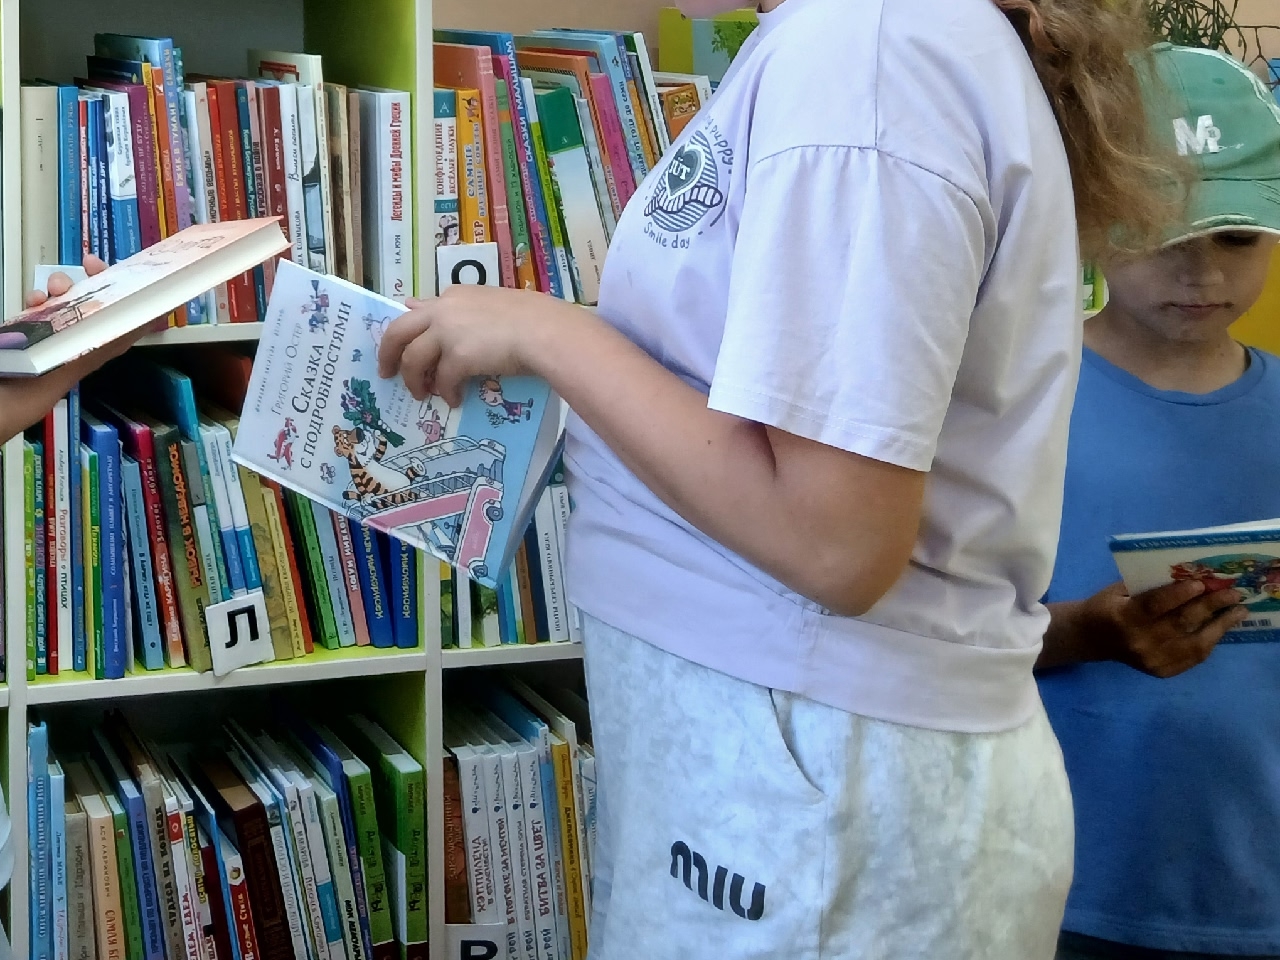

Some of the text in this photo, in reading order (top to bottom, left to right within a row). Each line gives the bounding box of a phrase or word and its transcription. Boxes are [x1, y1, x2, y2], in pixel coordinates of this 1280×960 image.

[162, 48, 174, 86] СКАЗКИ
[389, 102, 401, 127] Греции
[506, 40, 534, 162] СКАЗКИ МАЛЫШАМ
[166, 101, 180, 144] ТУМАНЕ
[446, 125, 455, 153] НАУКИ
[389, 129, 403, 158] Древней
[389, 160, 402, 182] мифы
[463, 143, 476, 196] САМЫЕ
[389, 190, 402, 221] Легенды
[642, 222, 691, 250] Smile day
[300, 301, 355, 456] ПОДРОБНОСТЯМИ
[167, 442, 201, 587] РЫВОК В НЕВЕДОМОЕ
[57, 509, 68, 561] Разговоры
[158, 552, 173, 604] КАРЯГИНА
[225, 604, 260, 649] Л
[529, 818, 545, 851] ЦВЕТ
[533, 852, 545, 868] ЗА
[534, 871, 551, 915] БИТВА
[105, 909, 118, 945] САМАЯ
